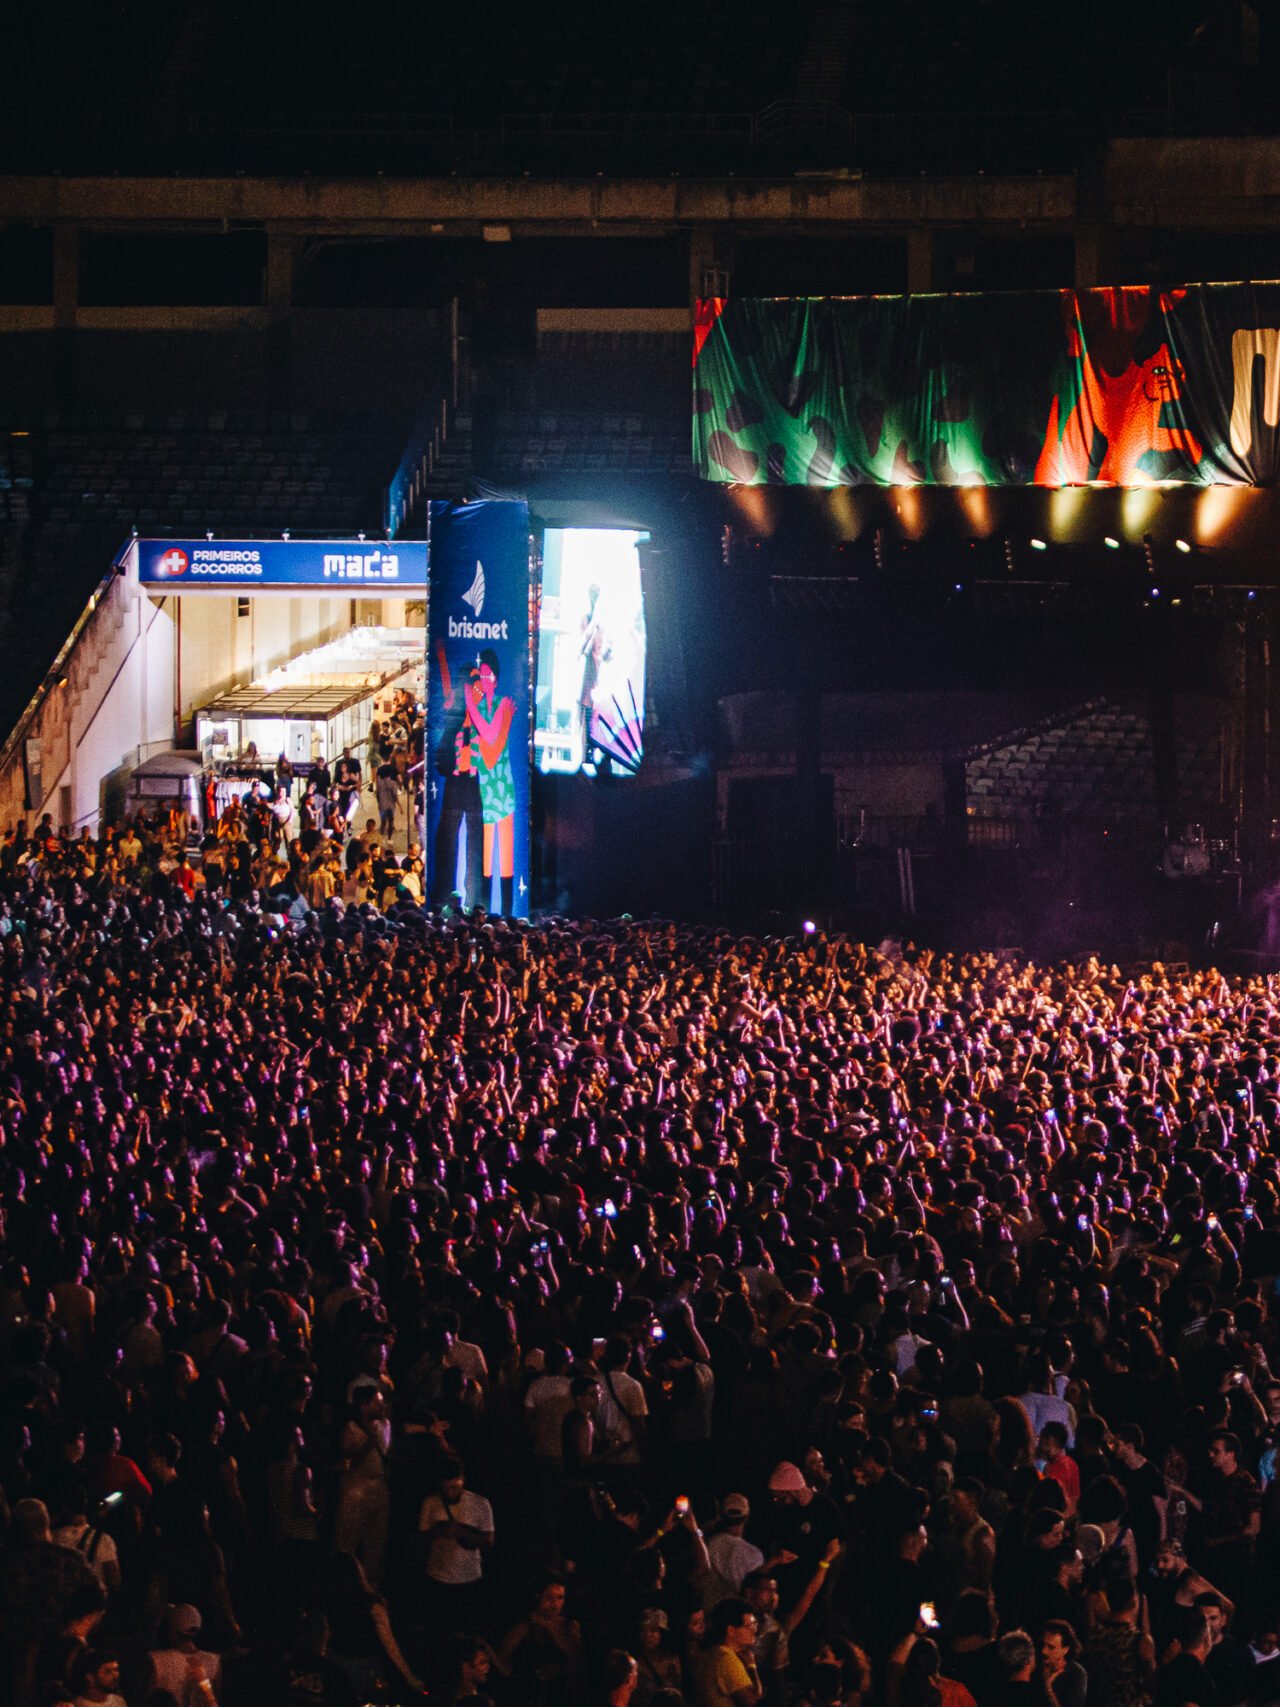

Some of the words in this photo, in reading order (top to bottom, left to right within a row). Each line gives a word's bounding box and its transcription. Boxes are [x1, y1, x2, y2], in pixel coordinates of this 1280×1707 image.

[193, 550, 261, 562] PRIMEIROS
[190, 563, 263, 575] SOCORROS
[448, 615, 508, 640] brisanet
